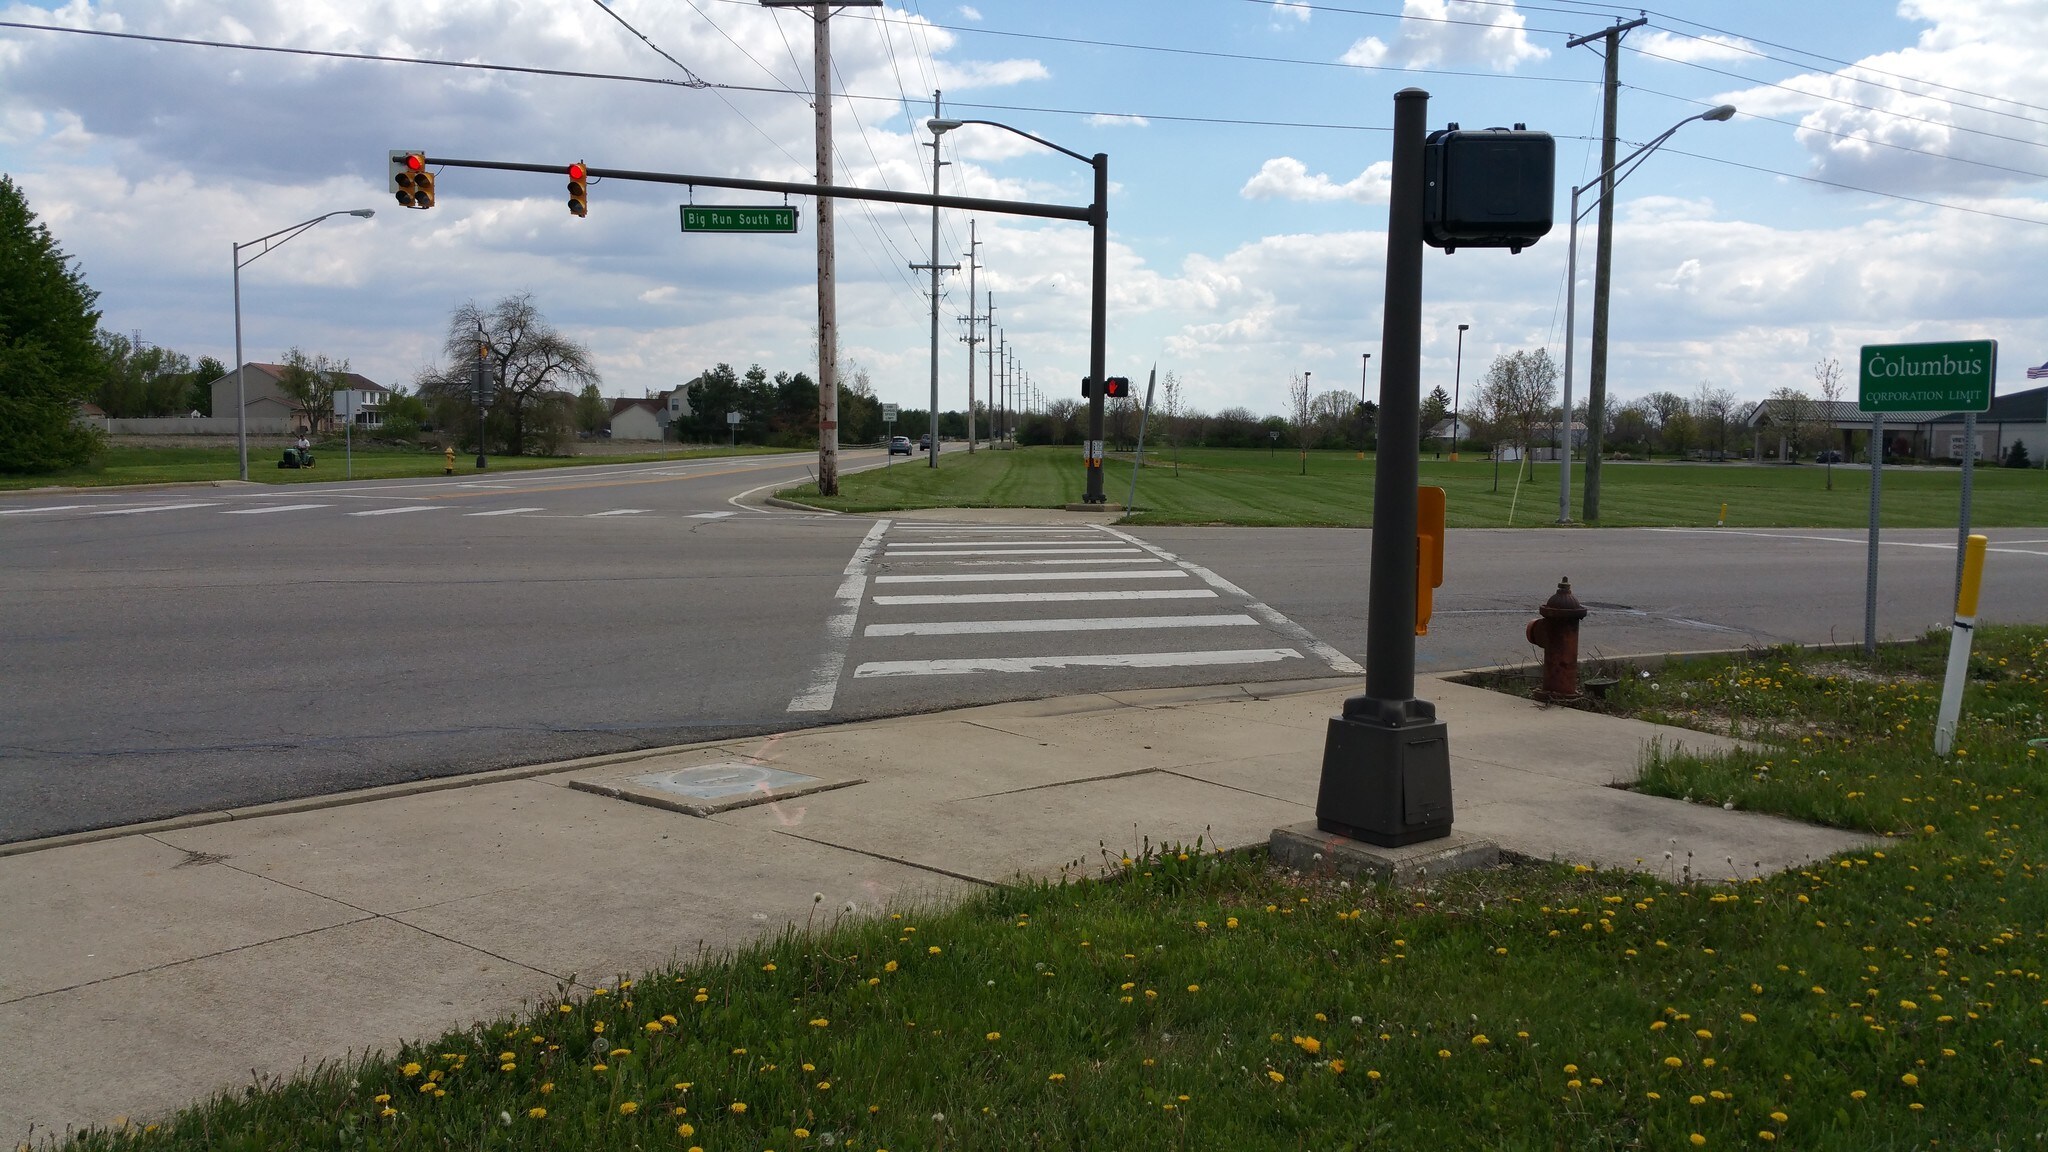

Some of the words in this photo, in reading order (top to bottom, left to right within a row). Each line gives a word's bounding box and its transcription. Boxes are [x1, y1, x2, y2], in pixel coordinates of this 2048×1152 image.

[688, 213, 706, 227] Big
[712, 213, 732, 225] Run
[739, 213, 770, 225] South
[776, 213, 789, 225] Rd
[1868, 354, 1982, 378] Columbus
[1866, 390, 1944, 402] CORPORATION
[1949, 389, 1982, 401] LIMIT
